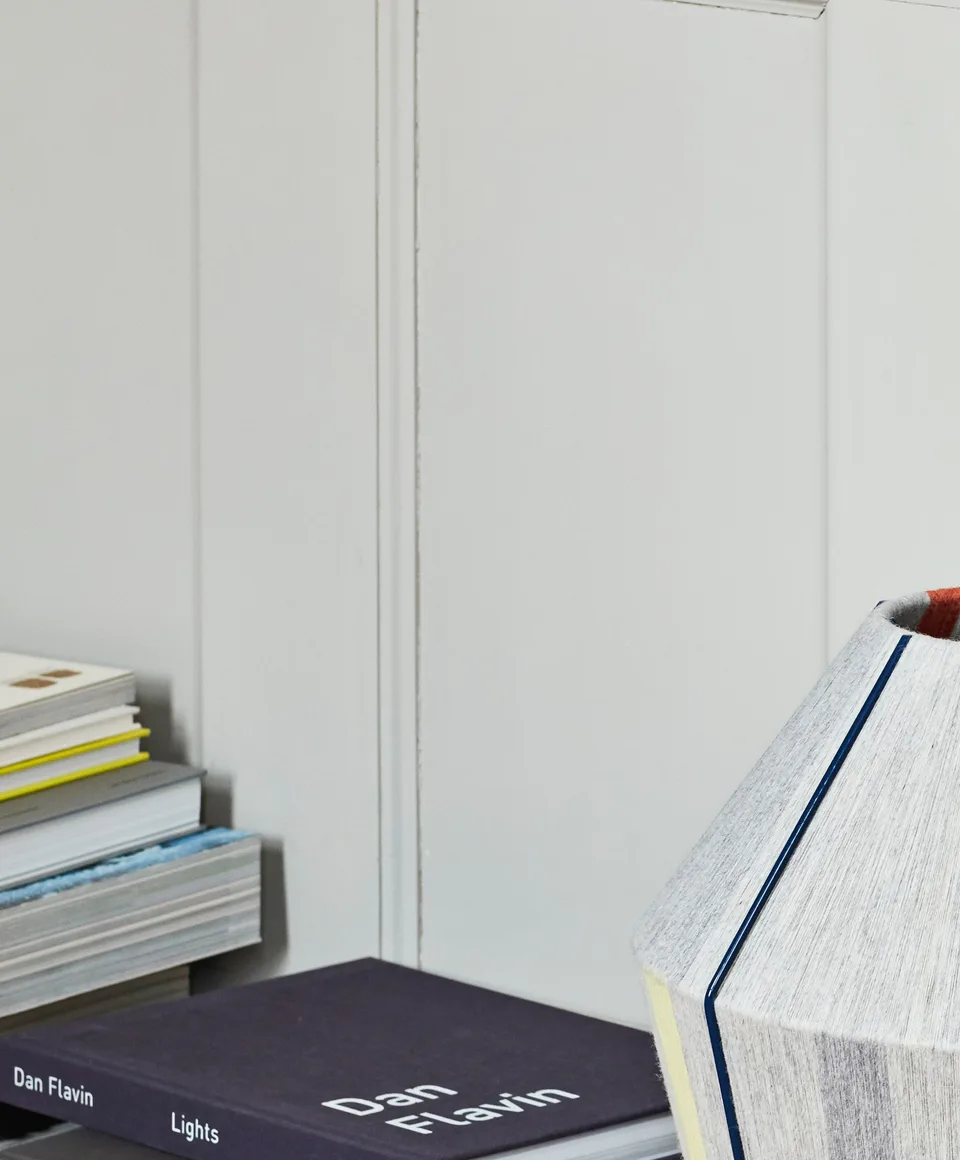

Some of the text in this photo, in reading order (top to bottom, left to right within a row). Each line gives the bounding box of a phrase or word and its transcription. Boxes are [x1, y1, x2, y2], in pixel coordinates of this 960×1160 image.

[14, 1066, 94, 1107] Dan Flavin
[321, 1084, 458, 1116] Dan
[171, 1112, 220, 1144] Lights
[385, 1088, 580, 1135] Flavin
